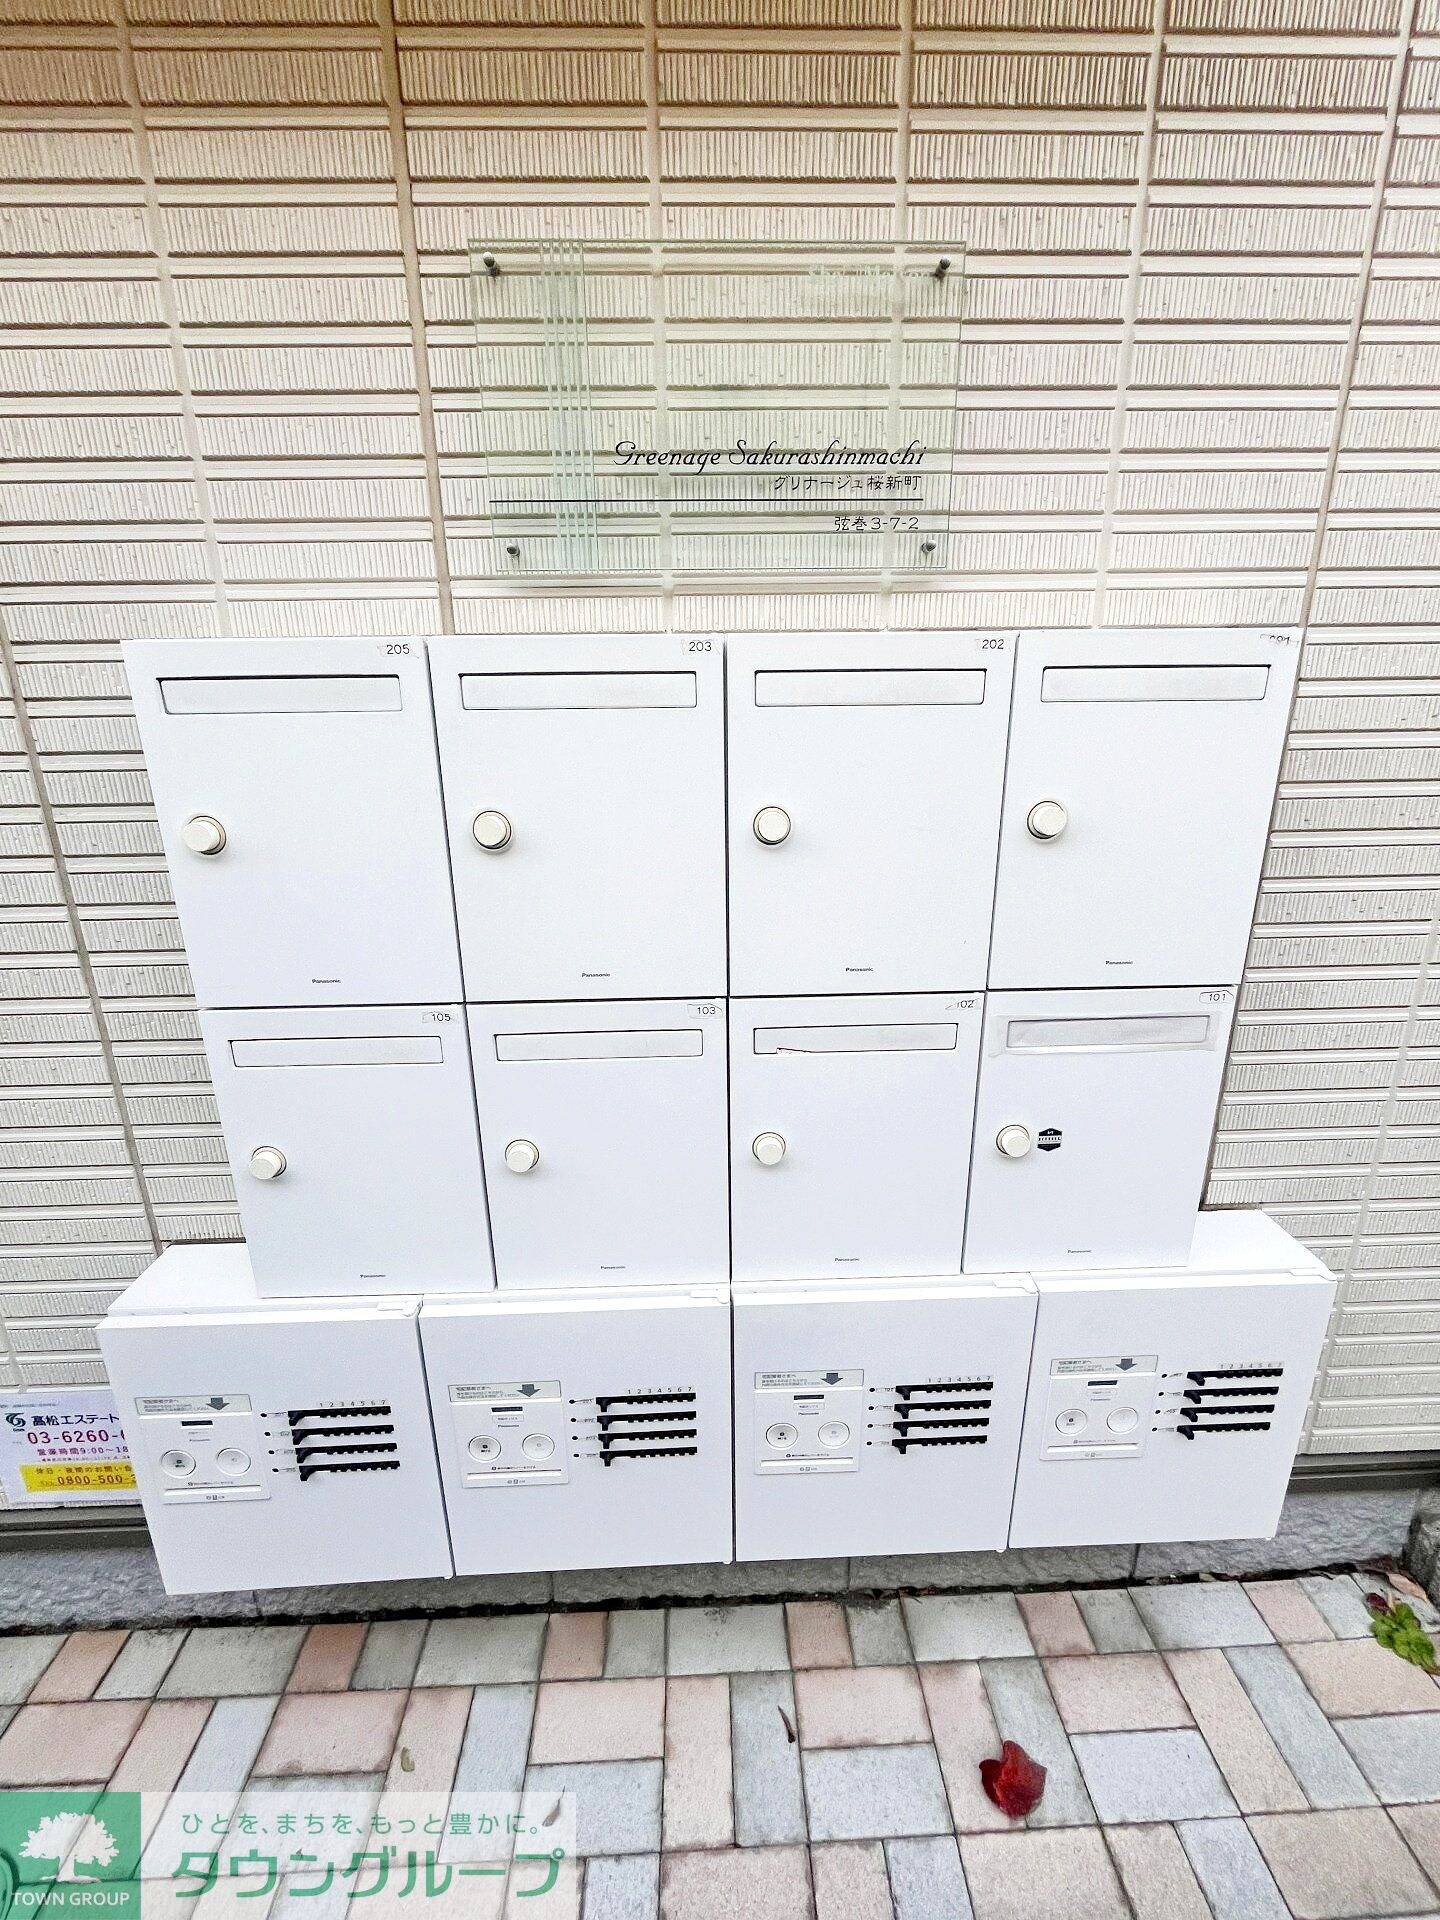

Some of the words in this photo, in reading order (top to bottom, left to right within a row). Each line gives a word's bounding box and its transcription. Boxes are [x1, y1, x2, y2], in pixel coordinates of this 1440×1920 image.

[613, 440, 720, 475] Greenage
[728, 439, 925, 466] Sakurashinmachi
[773, 475, 922, 491] グリナージュ桜新町
[833, 516, 919, 532] 弦巻3-7-2
[386, 644, 410, 656] 205
[688, 641, 713, 653] 203
[981, 638, 1005, 650] 202
[311, 977, 342, 985] Panasonic
[1208, 993, 1226, 1002] 101
[956, 999, 974, 1009] 102
[430, 1012, 451, 1022] 105
[696, 1006, 716, 1016] 103
